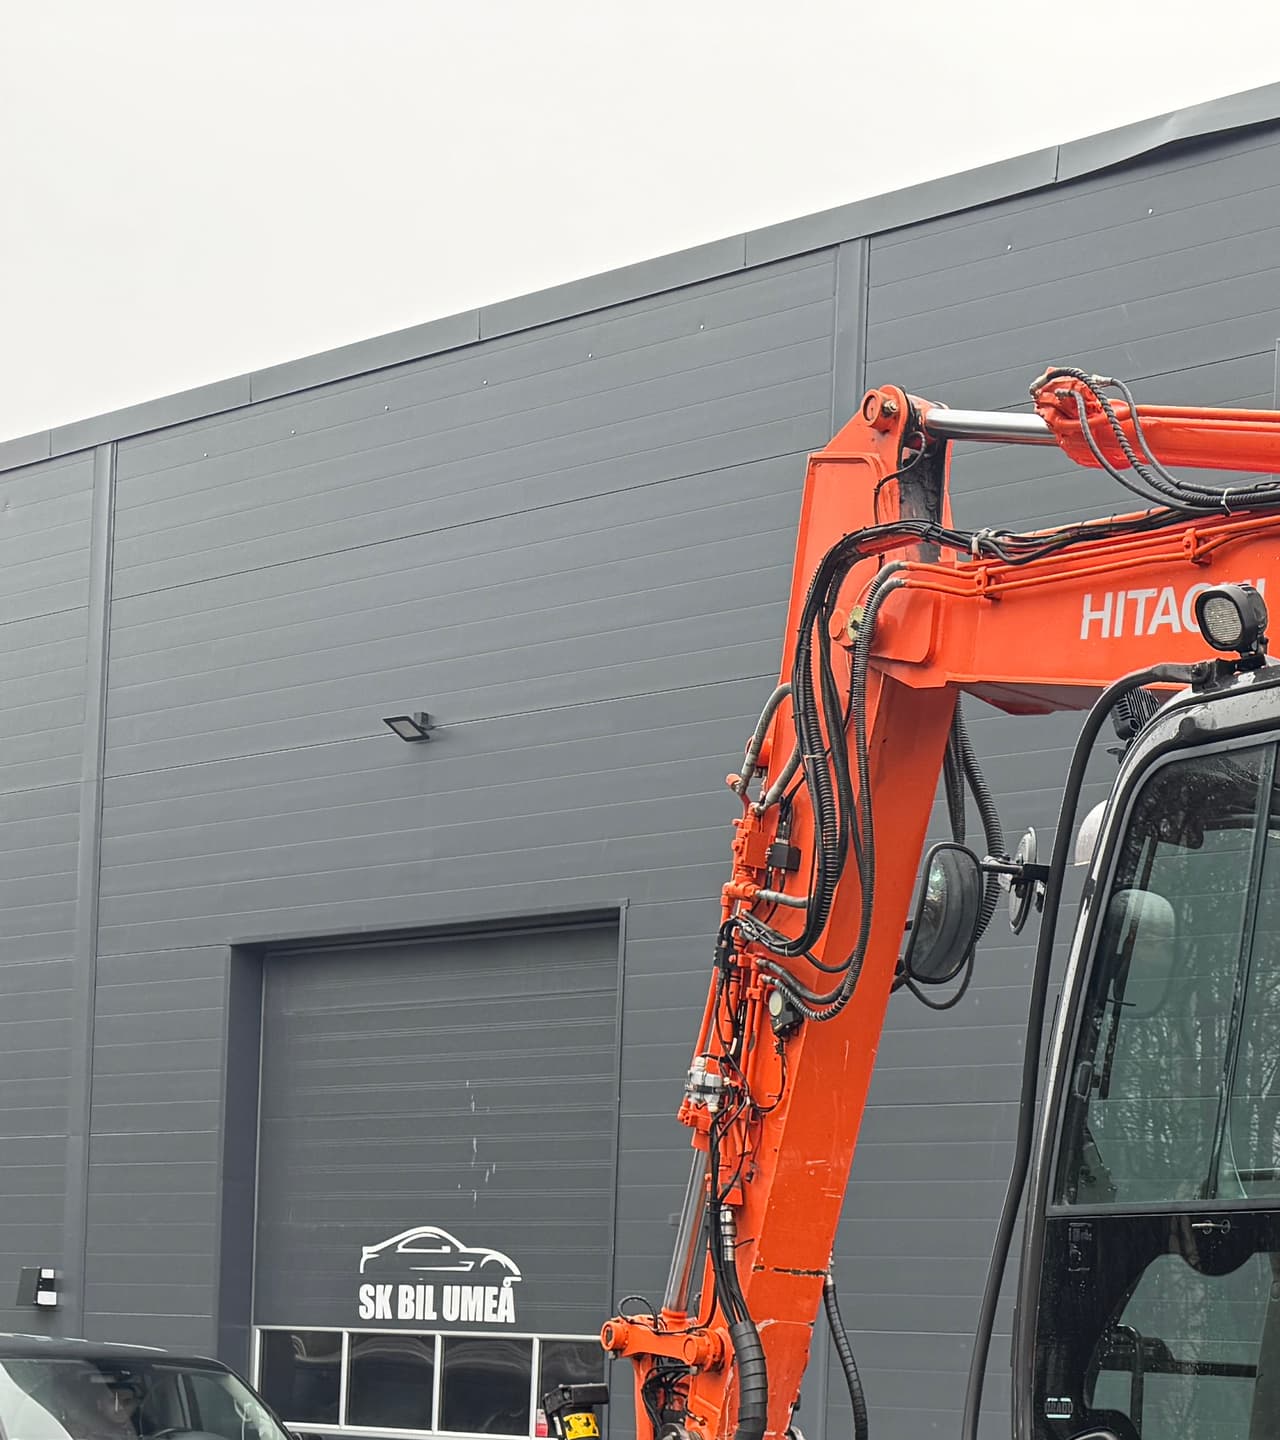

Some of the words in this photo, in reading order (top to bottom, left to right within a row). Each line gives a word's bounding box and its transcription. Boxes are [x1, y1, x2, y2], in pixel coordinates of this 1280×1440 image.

[358, 1283, 394, 1320] SK
[397, 1284, 437, 1320] BIL
[442, 1277, 516, 1323] UMEÅ
